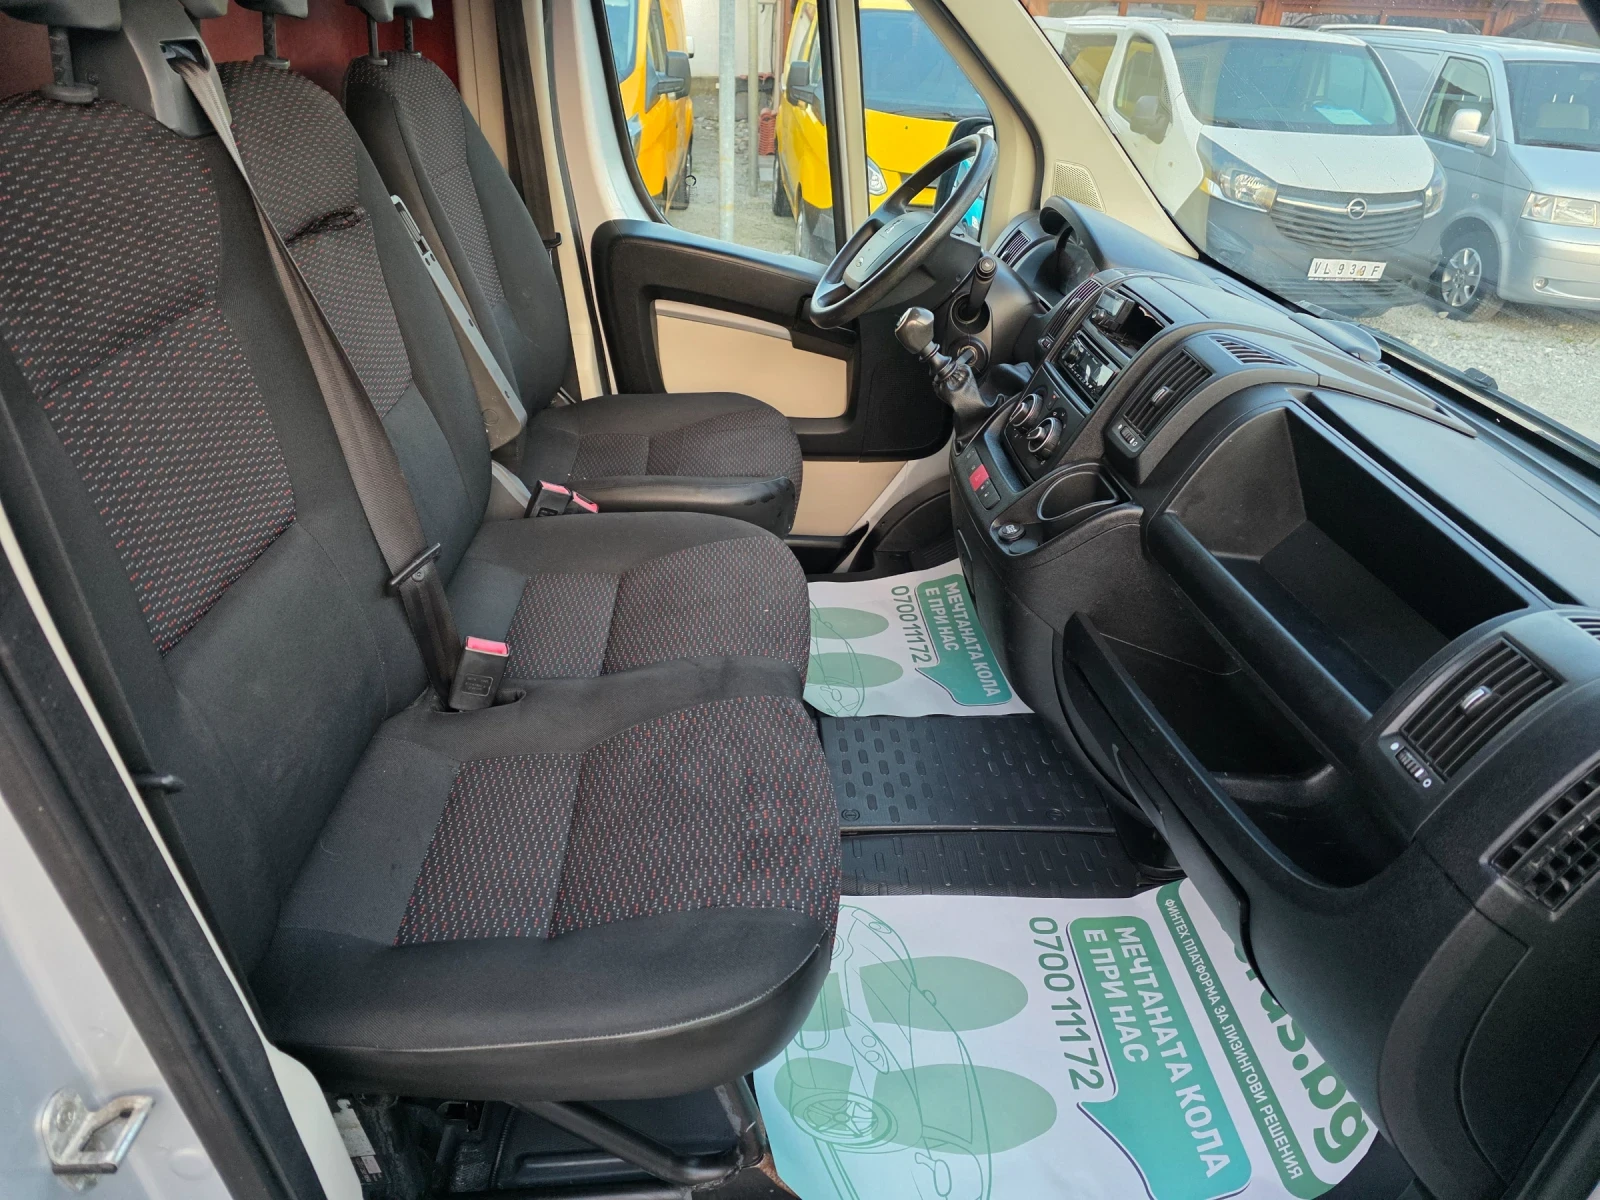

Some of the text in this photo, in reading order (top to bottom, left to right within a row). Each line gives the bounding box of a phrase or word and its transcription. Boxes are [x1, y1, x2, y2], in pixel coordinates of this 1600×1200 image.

[928, 598, 950, 624] ПРИ
[937, 626, 960, 651] НАС
[944, 581, 1001, 697] МЕЧТАНАТА КОЛА
[1083, 929, 1149, 1063] Е ПРИ НАС
[1114, 926, 1231, 1178] МЕЧТАНАТА КОЛА
[1164, 898, 1304, 1180] ФИНТЕХ ПЛАТФОРМА ЗА ЛИЗИНГОВИ РЕШЕНИЯ
